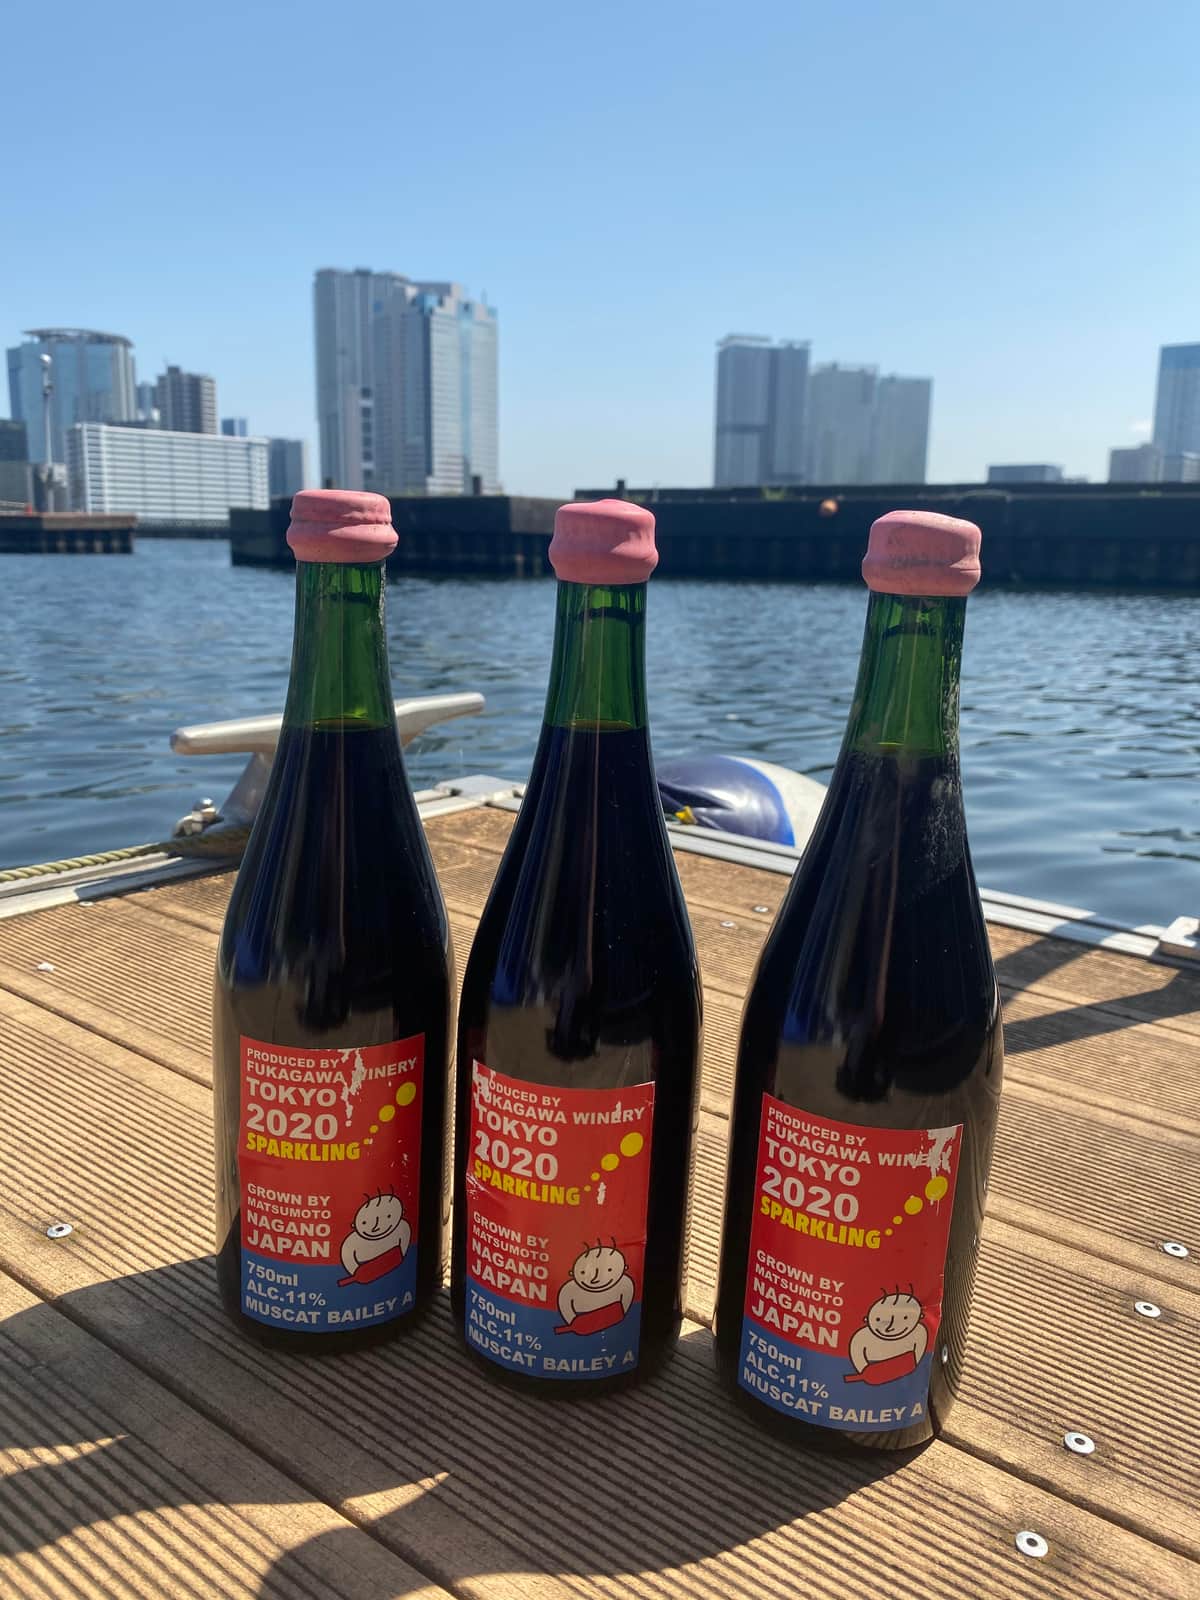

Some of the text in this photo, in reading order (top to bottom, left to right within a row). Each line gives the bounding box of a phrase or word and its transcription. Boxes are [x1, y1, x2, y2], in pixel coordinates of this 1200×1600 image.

[247, 1047, 339, 1068] PRODUCED BY
[247, 1060, 345, 1083] FUKAGAWA
[246, 1076, 337, 1107] TOKYO
[474, 1086, 645, 1125] UKAGAWA WINERY
[475, 1072, 561, 1107] ODUCED BY
[246, 1103, 338, 1141] 2020
[477, 1104, 558, 1146] TOKYO
[767, 1120, 871, 1164] FUKAGAWA
[768, 1107, 867, 1147] PRODUCED BY
[246, 1132, 361, 1161] SPARKLING
[475, 1130, 558, 1181] 2020
[766, 1137, 861, 1187] TOKYO
[248, 1183, 331, 1207] GROWN BY
[473, 1159, 580, 1206] SPARKLING
[761, 1165, 859, 1223] 2020
[247, 1196, 331, 1219] MATSUMOTO
[247, 1210, 331, 1237] NAGANO
[760, 1195, 881, 1249] SPARKLING
[247, 1230, 330, 1258] JAPAN
[473, 1211, 549, 1249] GROWN BY
[473, 1225, 549, 1262] MATSUMOTO
[247, 1261, 298, 1287] 750ml
[472, 1239, 548, 1280] NAGANO
[756, 1250, 845, 1293] GROWN BY
[247, 1279, 326, 1306] ALC.11%
[471, 1259, 547, 1302] JAPAN
[755, 1264, 844, 1307] MATSUMOTO
[246, 1291, 412, 1324] MUSCAT BAILEY A
[470, 1290, 515, 1326] 750ml
[753, 1277, 841, 1325] NAGANO
[470, 1309, 542, 1351] ALC.11%
[751, 1299, 838, 1348] JAPAN
[468, 1325, 634, 1372] MUSCAT BAILEY A
[749, 1331, 801, 1371] 750ml
[743, 1367, 923, 1423] MUSCAT BAILEY A
[746, 1351, 829, 1399] ALC.11%
